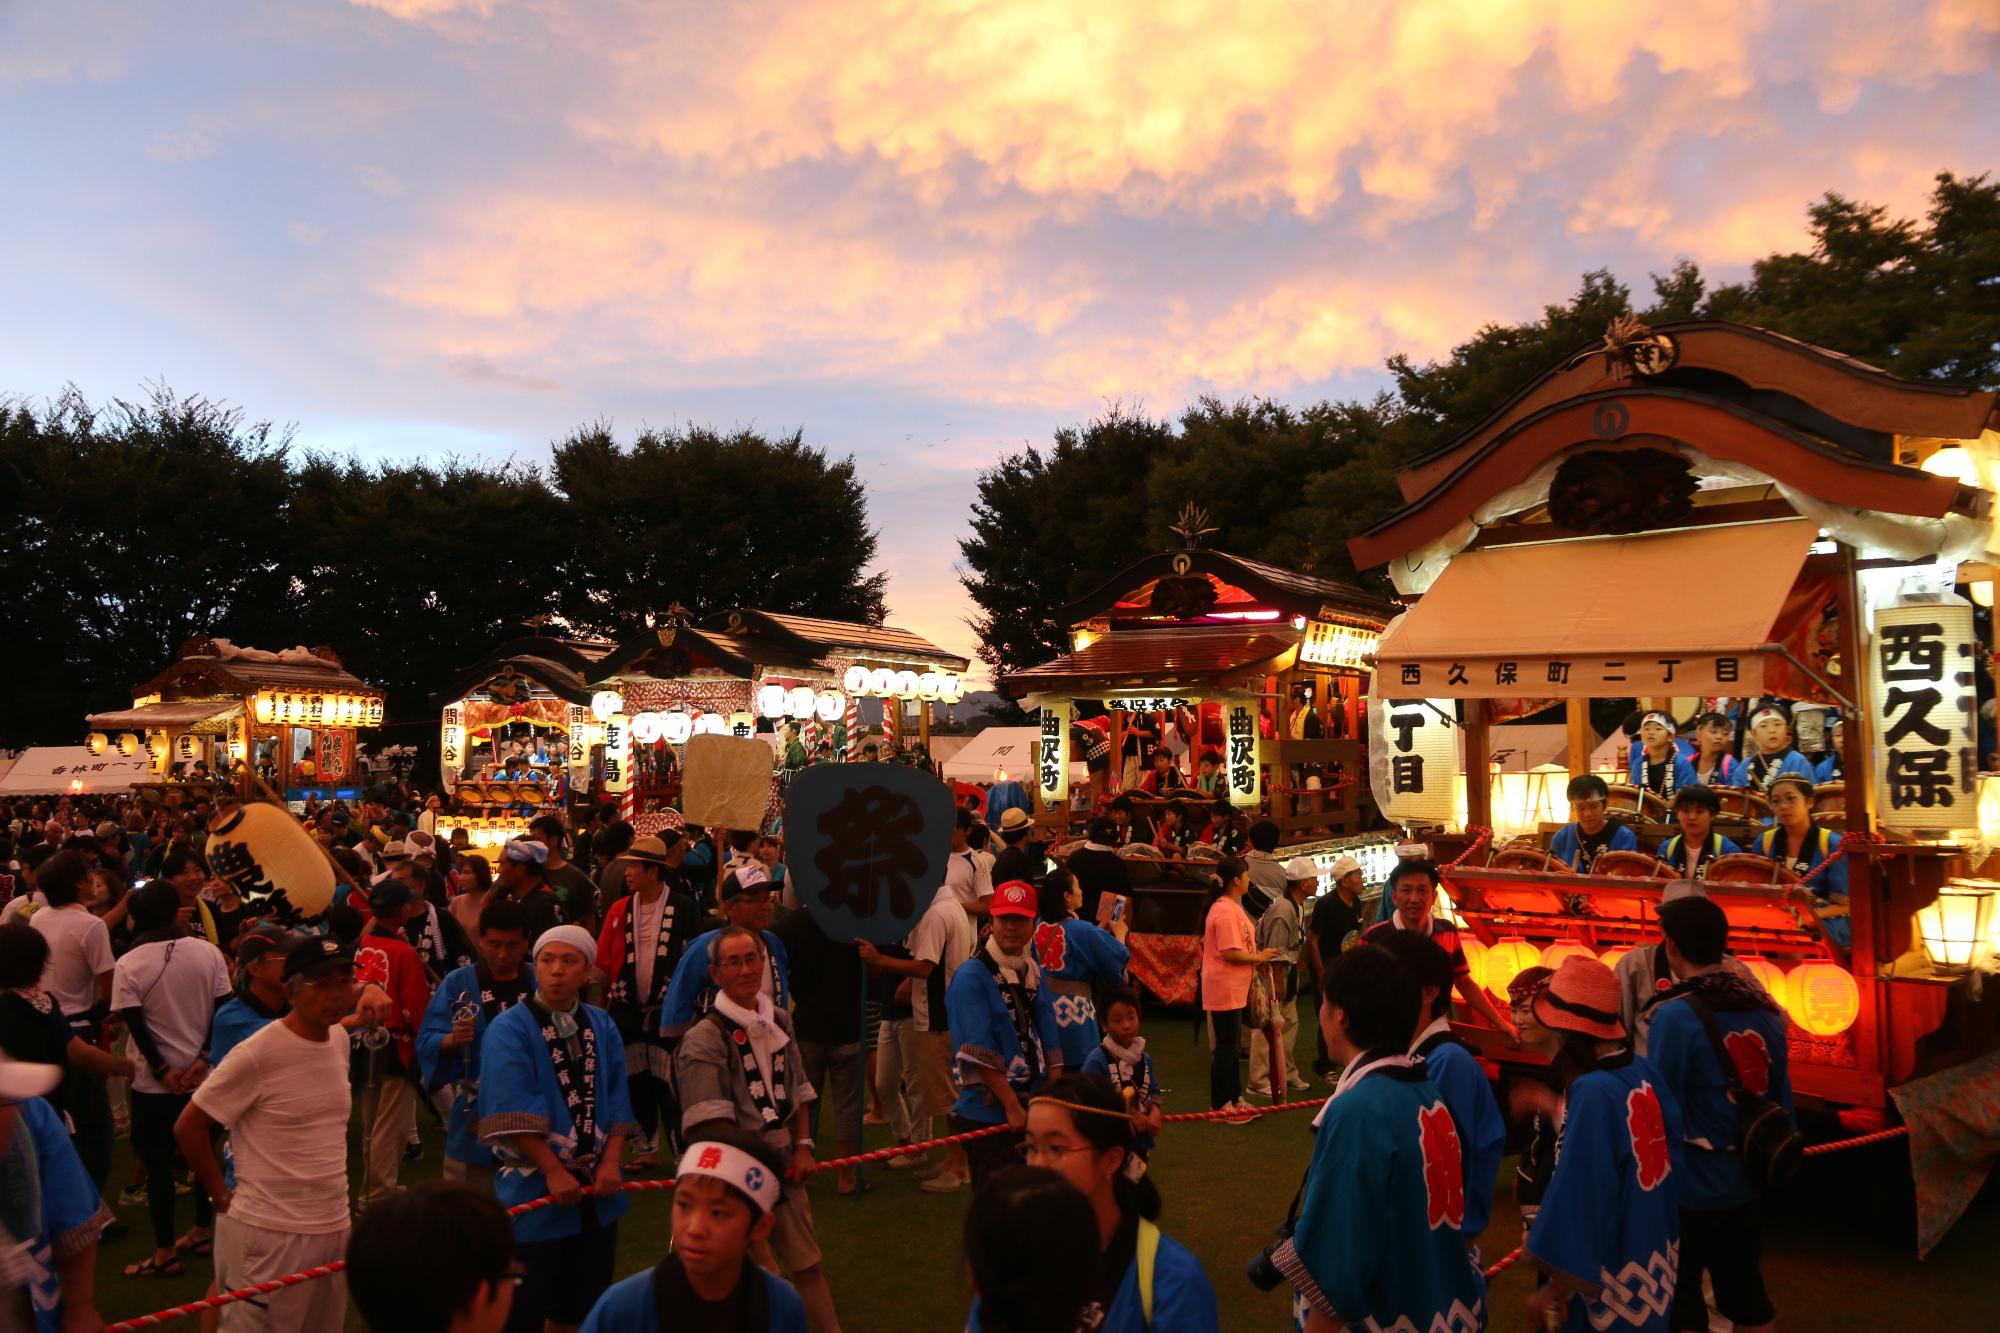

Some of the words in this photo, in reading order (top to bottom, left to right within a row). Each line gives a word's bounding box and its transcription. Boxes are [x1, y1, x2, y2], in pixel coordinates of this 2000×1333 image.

[1400, 657, 1740, 686] 西久保町二丁目
[444, 708, 458, 762] 間野谷
[570, 706, 584, 761] 間野谷
[1880, 622, 1954, 811] 西久保
[606, 723, 621, 783] 鹿島
[1041, 709, 1060, 792] 曲沢町
[1229, 706, 1256, 795] 曲沢町
[814, 784, 929, 921] 祭
[697, 1146, 723, 1169] 祭
